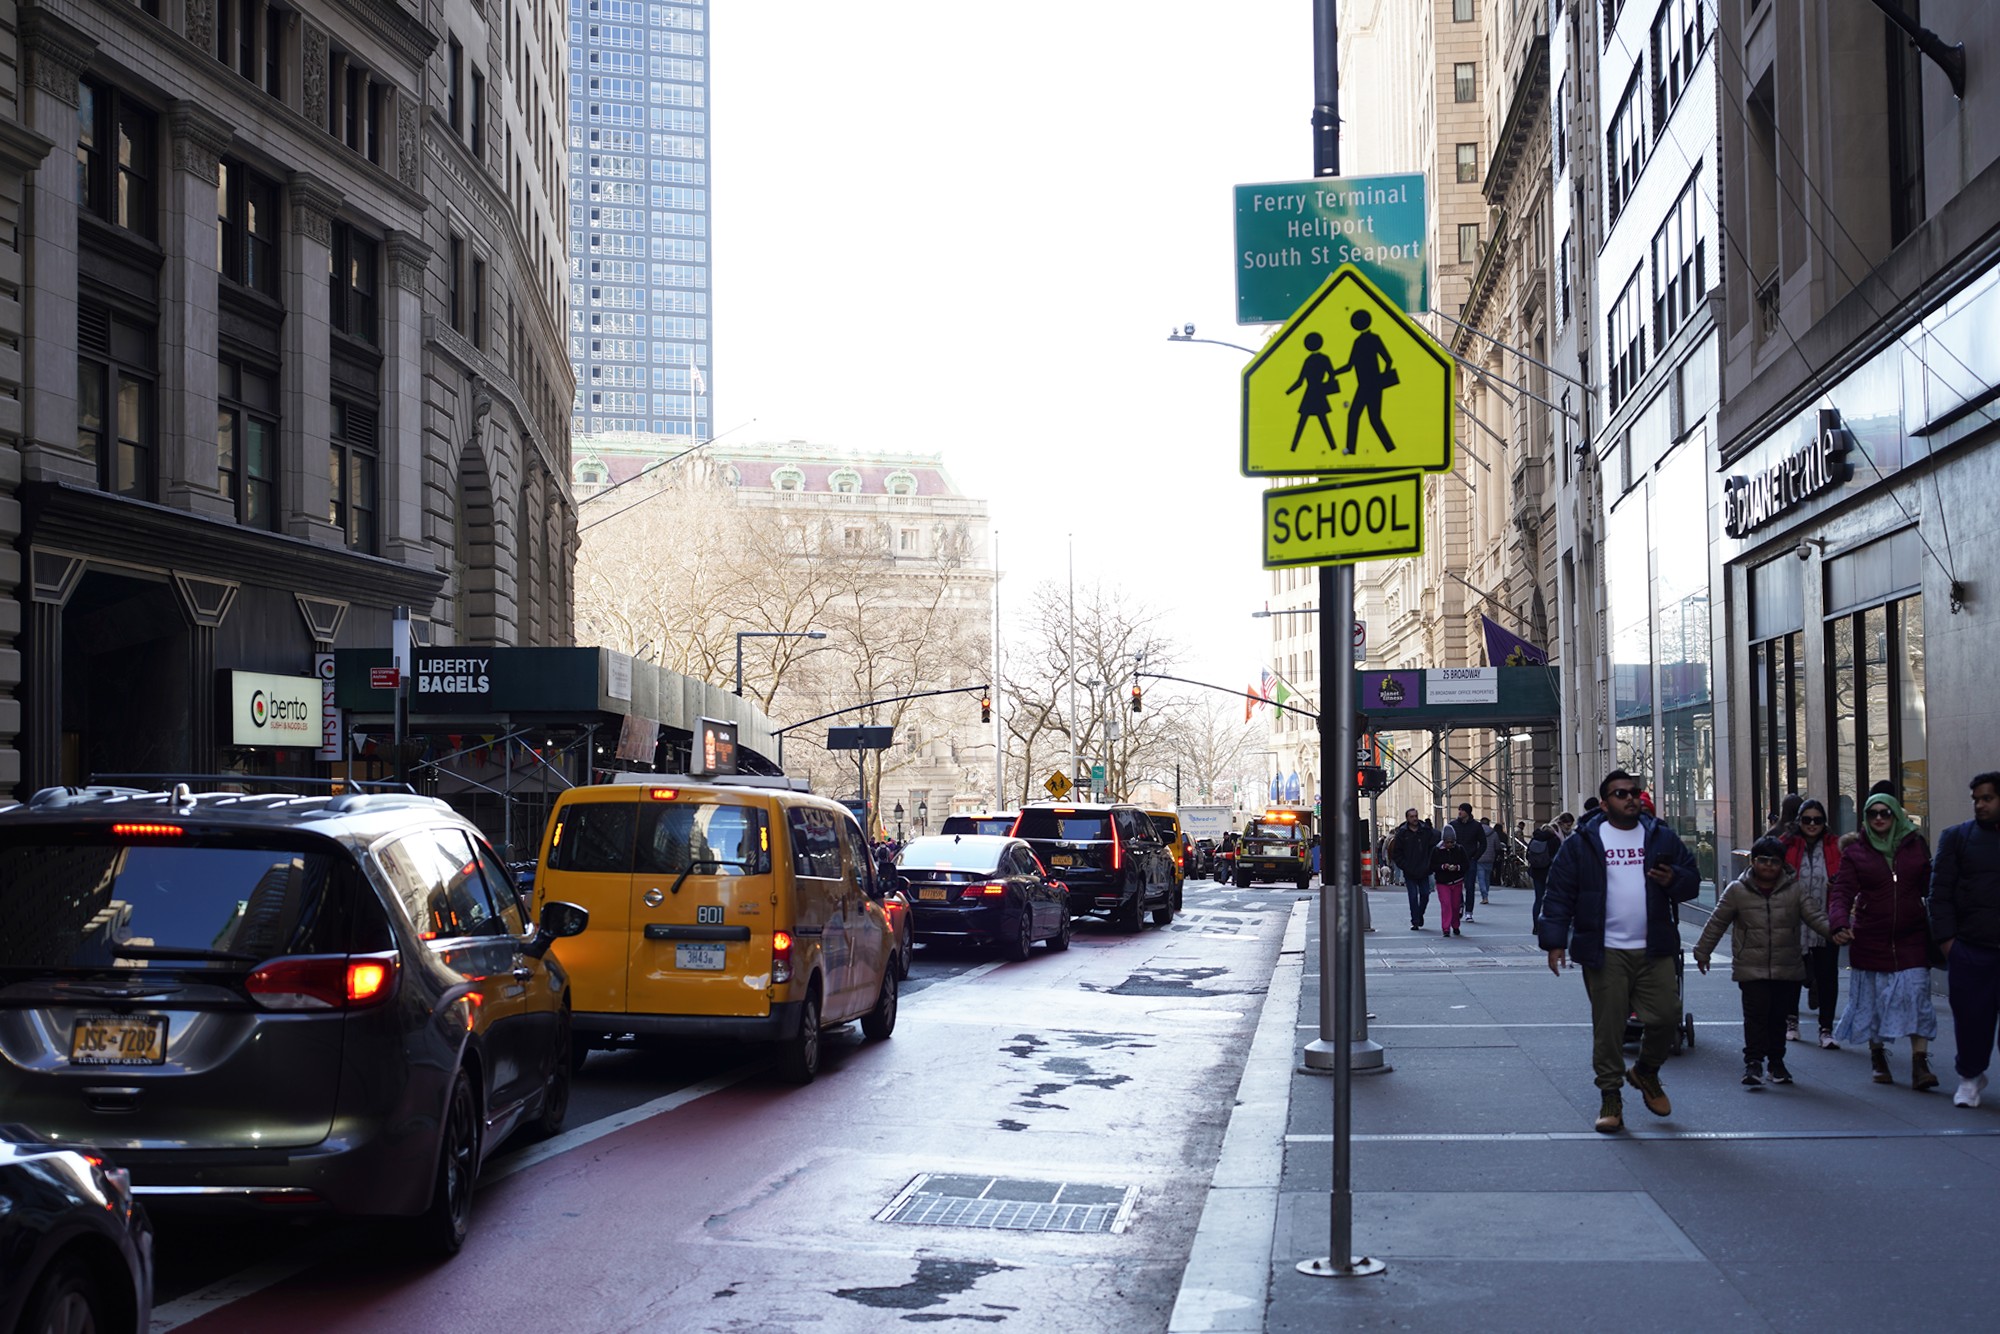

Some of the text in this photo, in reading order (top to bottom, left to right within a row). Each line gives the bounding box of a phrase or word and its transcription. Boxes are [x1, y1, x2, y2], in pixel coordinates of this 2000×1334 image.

[1253, 184, 1407, 214] Ferry Terminal
[1287, 214, 1375, 240] Heliport
[1243, 240, 1420, 270] South St Seaport
[1273, 494, 1410, 544] SCHOOL
[418, 659, 489, 673] LIBERTY
[1442, 669, 1481, 680] 25 BROADWAY
[418, 675, 490, 693] BAGELS
[270, 691, 308, 720] bento
[1605, 847, 1645, 859] GUES
[698, 906, 723, 924] 801
[78, 1057, 153, 1065] LUXURY OF QUEENS
